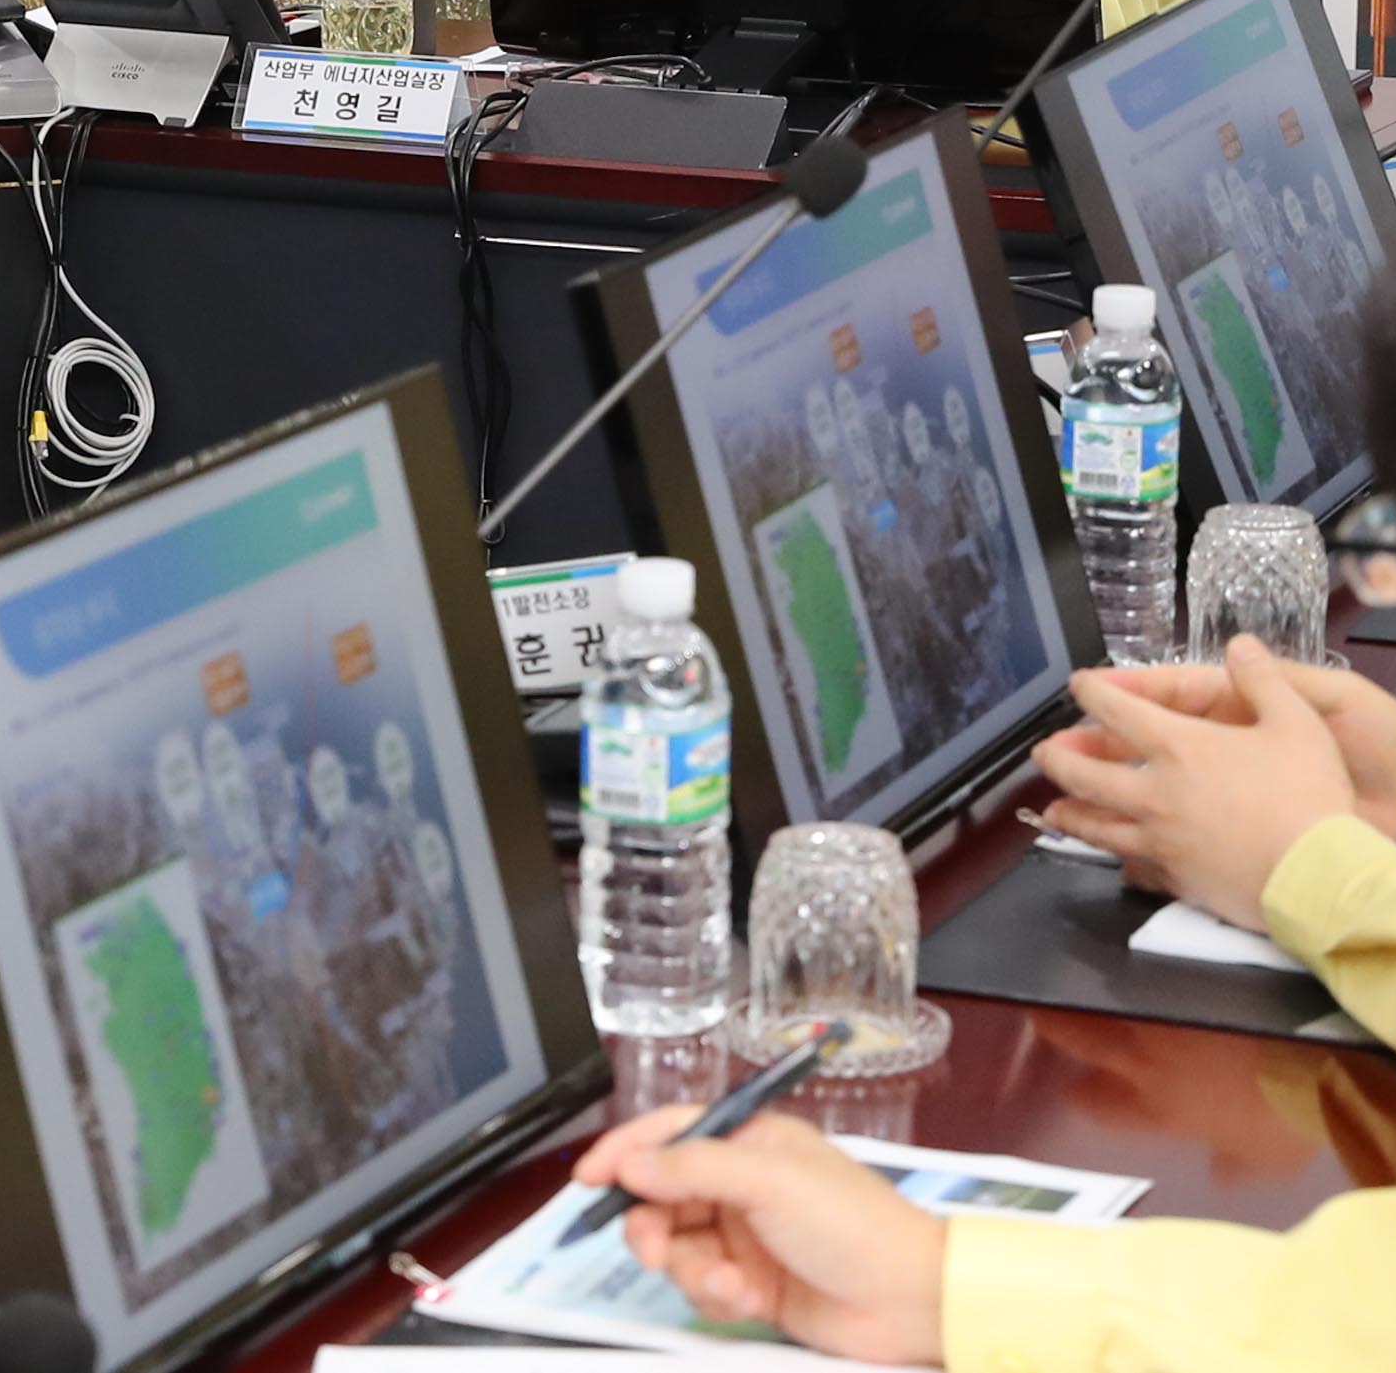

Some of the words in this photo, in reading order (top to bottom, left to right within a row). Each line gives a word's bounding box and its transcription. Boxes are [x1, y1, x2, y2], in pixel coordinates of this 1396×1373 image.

[264, 60, 315, 81] 산업부
[323, 65, 446, 91] 에너지산업실장
[294, 89, 319, 117] 천
[336, 92, 360, 121] 영
[377, 95, 402, 124] 길
[514, 632, 552, 676] 훈
